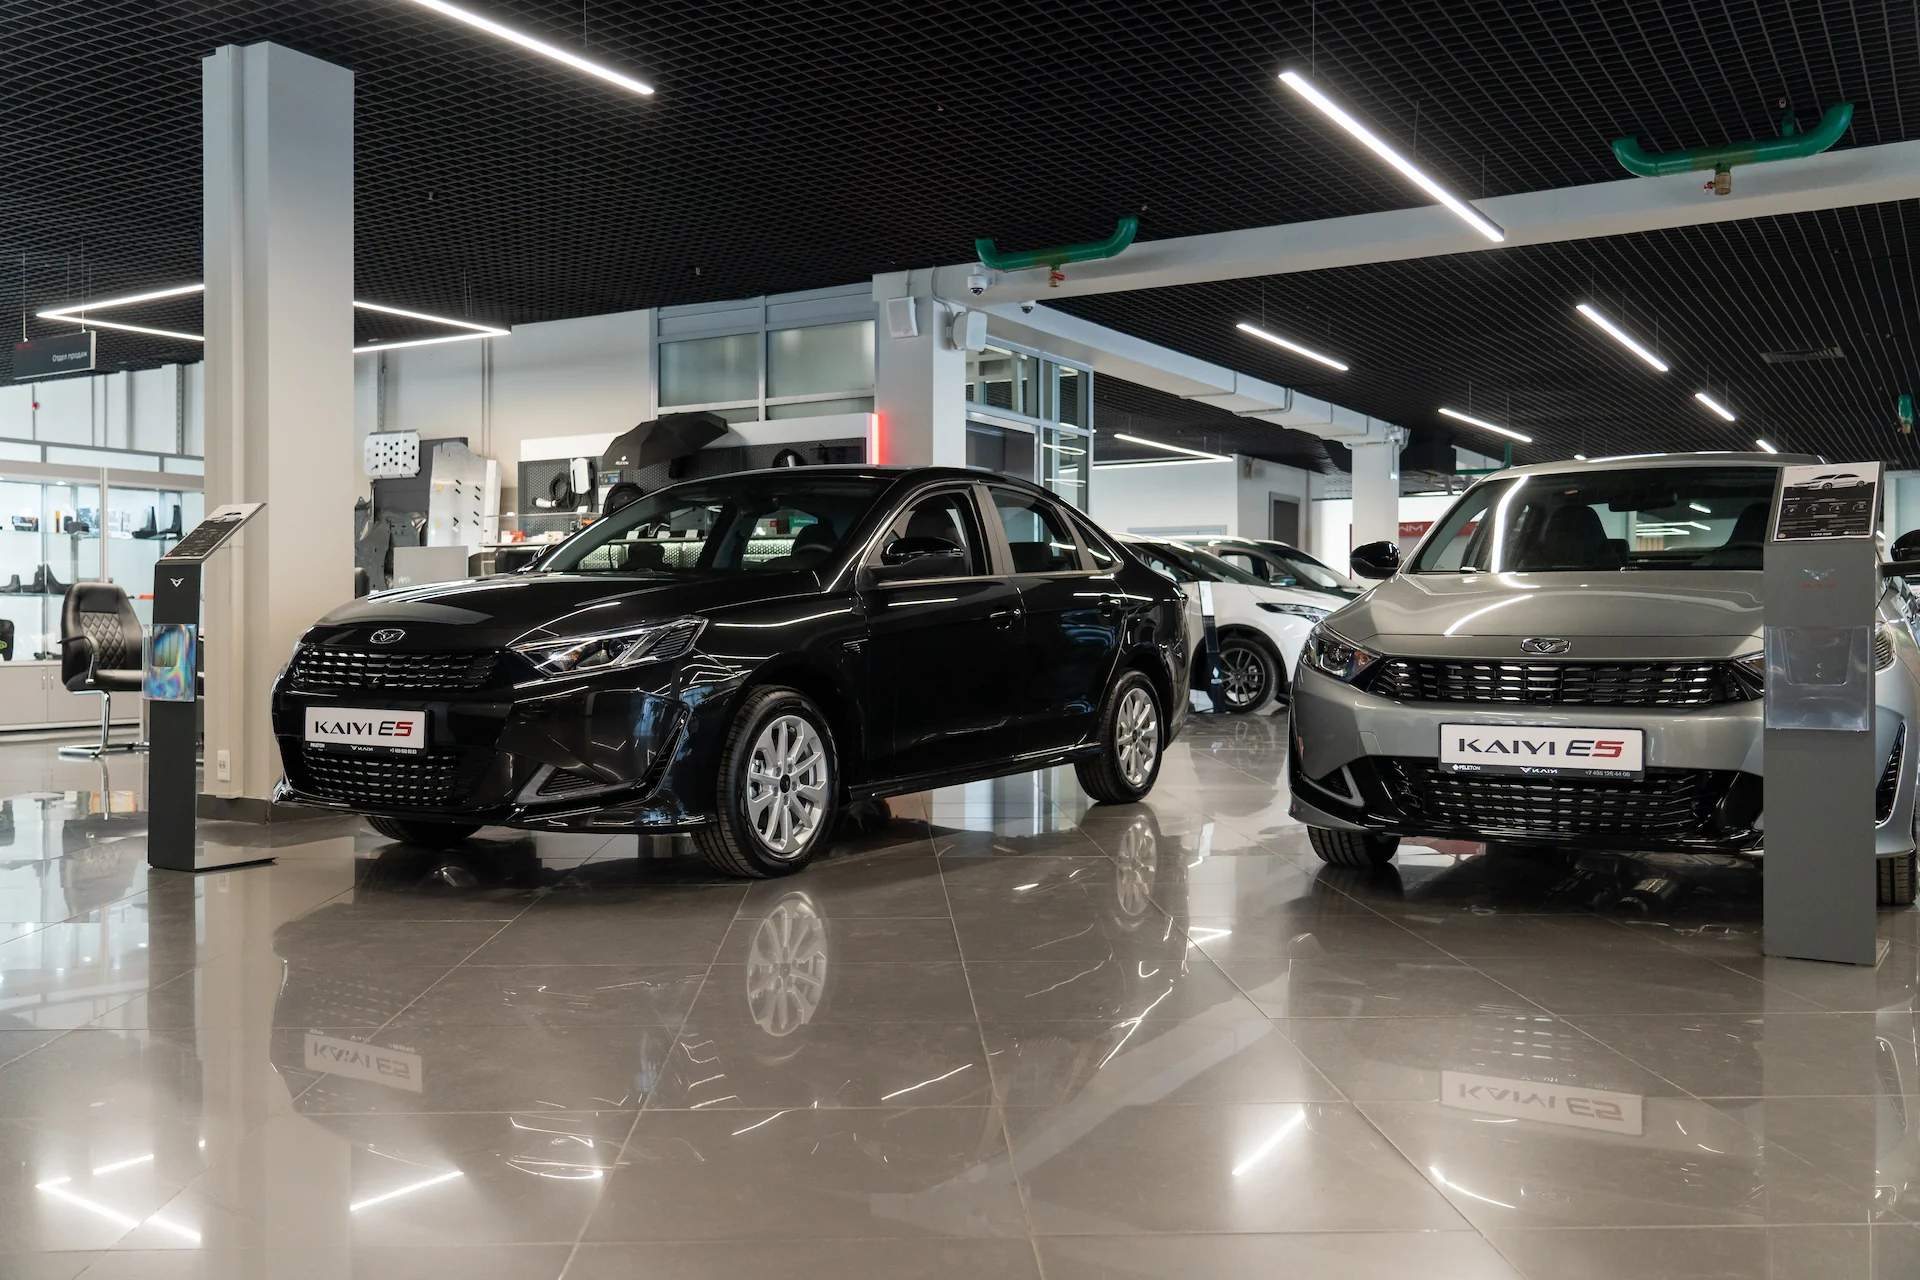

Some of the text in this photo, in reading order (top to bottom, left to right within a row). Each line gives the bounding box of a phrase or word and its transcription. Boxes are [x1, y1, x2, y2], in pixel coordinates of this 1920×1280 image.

[52, 351, 88, 362] Отдел продаж
[315, 721, 372, 735] KAIYI
[1459, 738, 1555, 755] KAIYI
